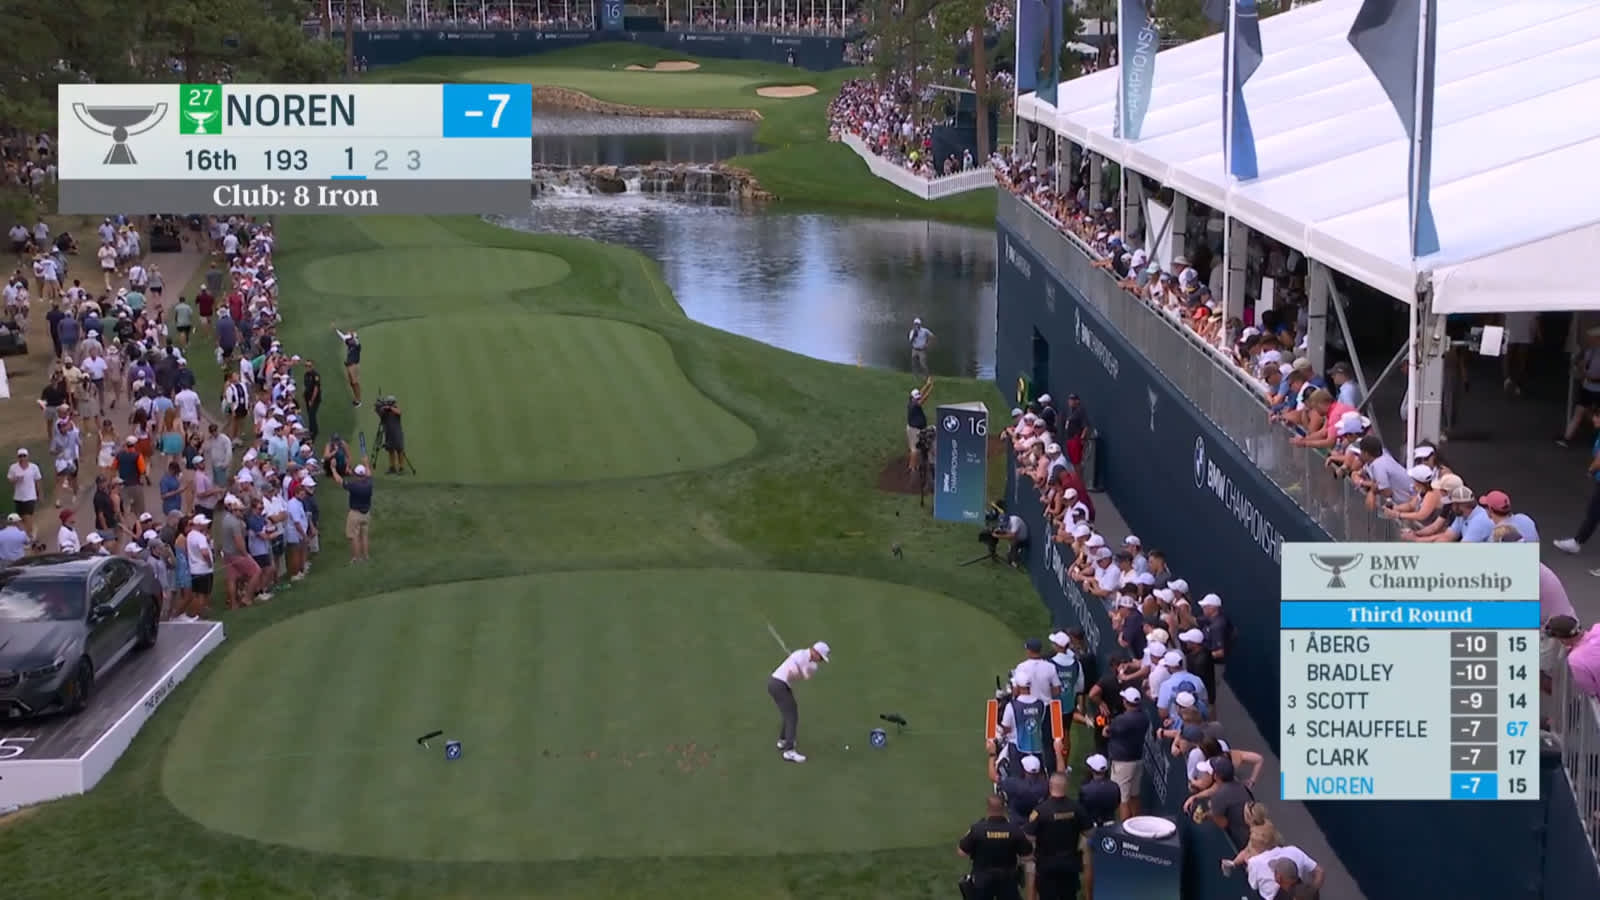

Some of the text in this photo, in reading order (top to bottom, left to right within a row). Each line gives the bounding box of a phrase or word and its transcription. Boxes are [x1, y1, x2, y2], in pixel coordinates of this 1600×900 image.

[605, 4, 620, 19] 16
[968, 416, 987, 437] 16
[1207, 458, 1286, 566] BMW CHAMPIONSHI
